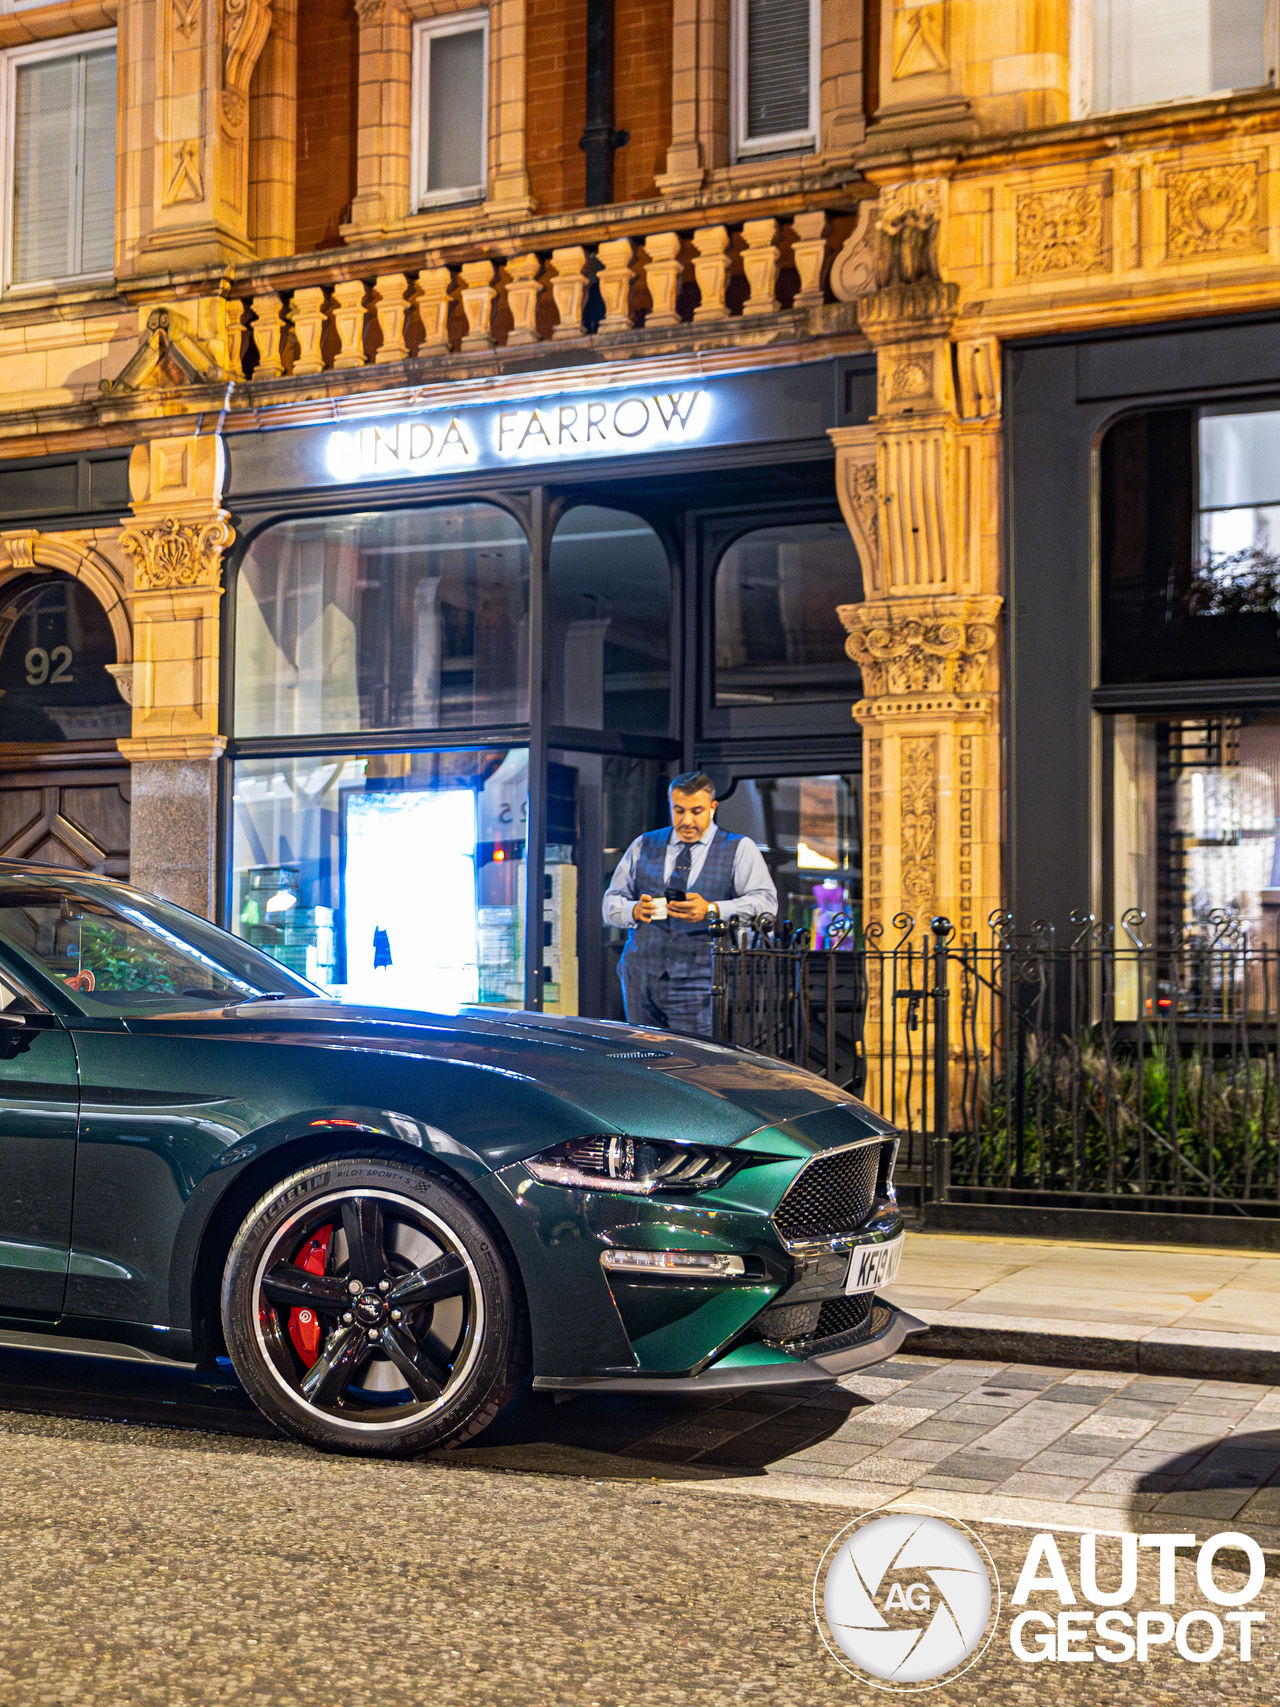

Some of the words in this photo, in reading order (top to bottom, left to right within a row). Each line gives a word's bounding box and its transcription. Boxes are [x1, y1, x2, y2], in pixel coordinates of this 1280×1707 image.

[331, 417, 470, 468] INDA
[498, 391, 701, 452] FARROW
[24, 645, 74, 686] 92
[253, 1171, 330, 1238] MICHELIN
[337, 1169, 363, 1178] PILOT
[366, 1169, 398, 1180] SPORT
[856, 1248, 888, 1287] KF19
